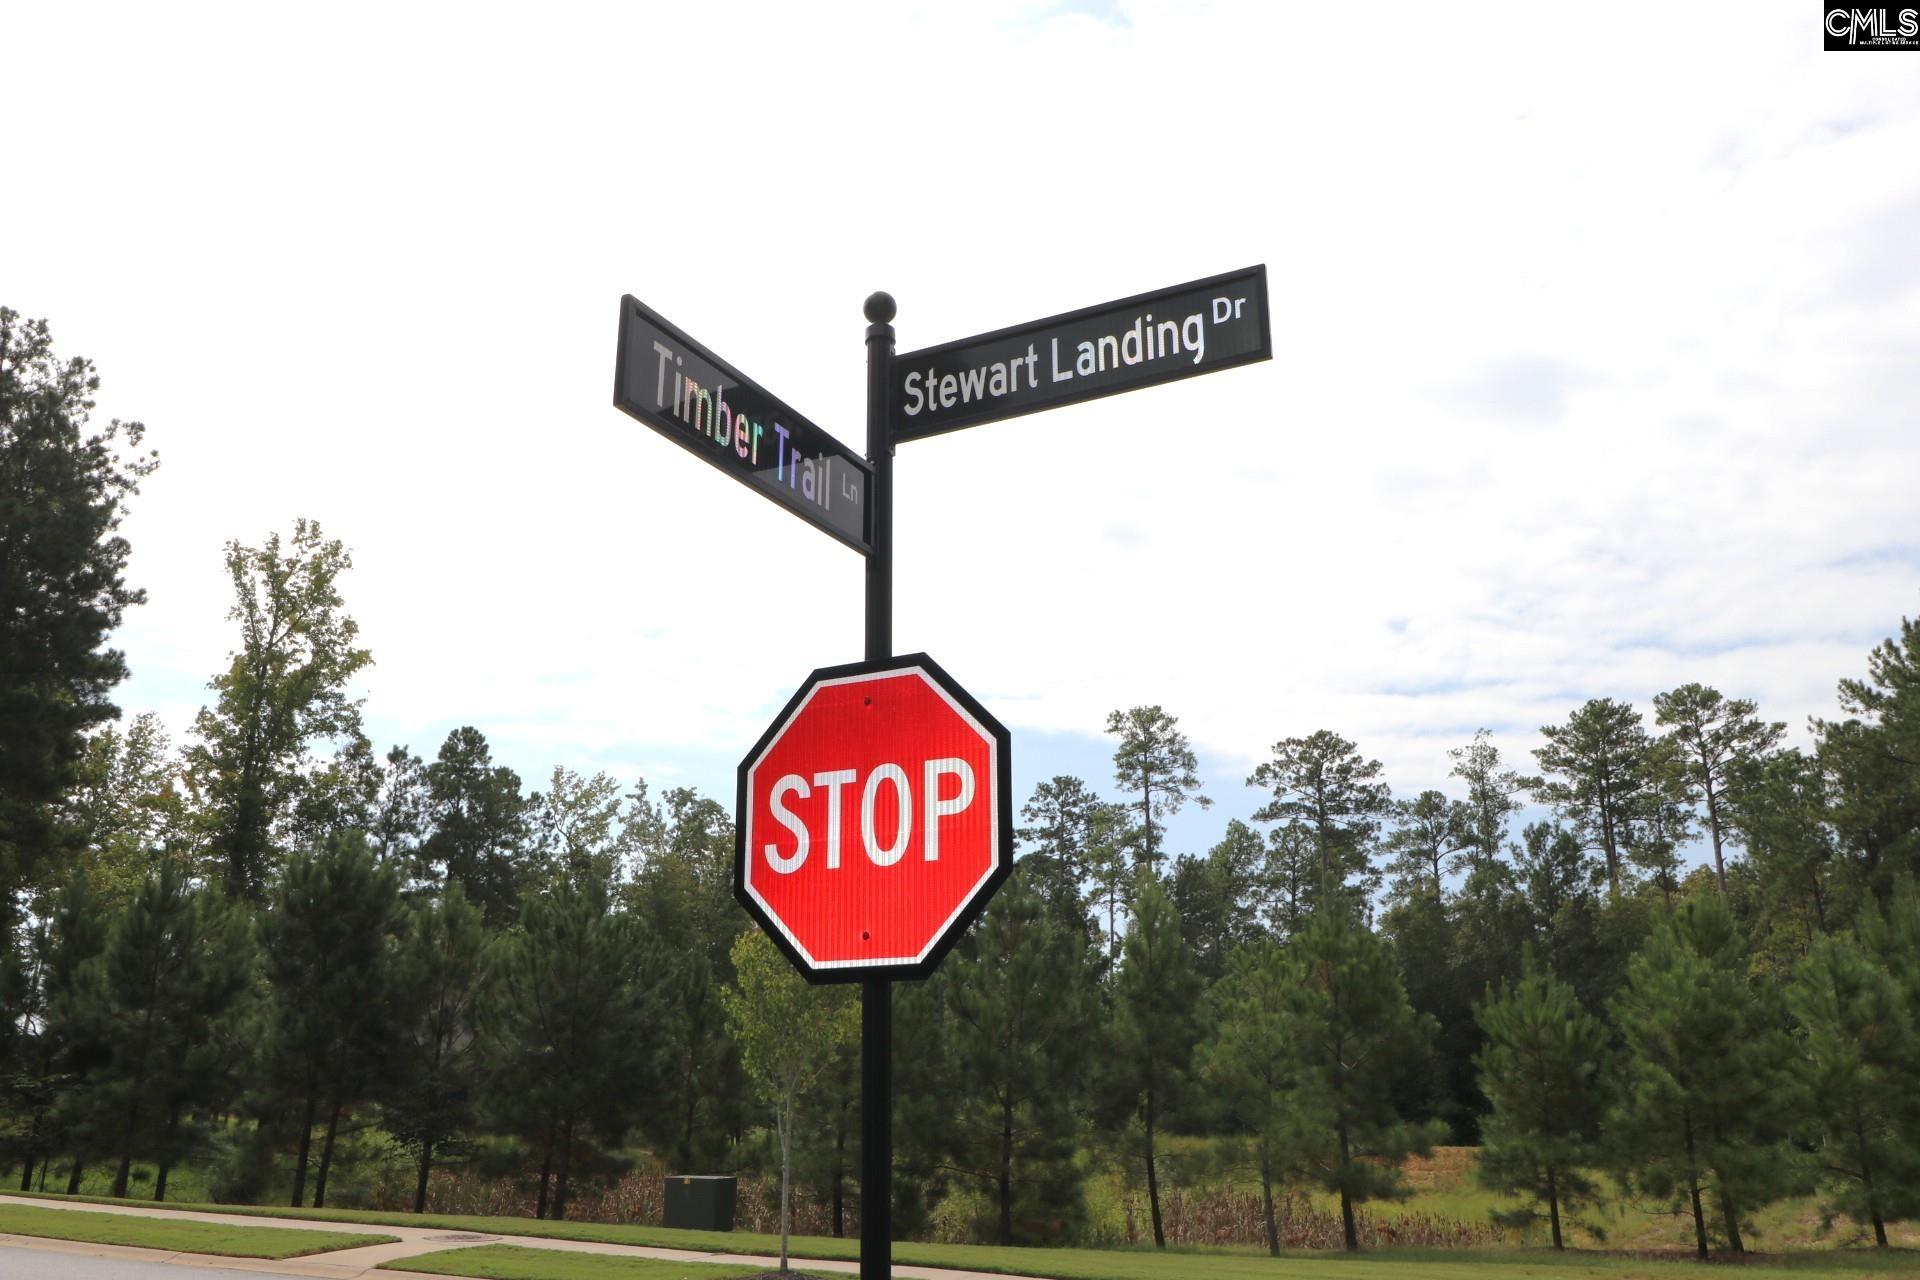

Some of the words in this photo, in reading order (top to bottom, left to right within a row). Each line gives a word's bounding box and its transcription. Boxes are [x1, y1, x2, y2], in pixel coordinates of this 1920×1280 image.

[903, 343, 1038, 417] Stewart
[1051, 312, 1205, 383] Landing
[1212, 296, 1246, 325] Dr
[653, 340, 763, 465] Timber
[774, 422, 830, 511] Trail
[842, 472, 858, 505] Ln
[764, 757, 976, 875] STOP
